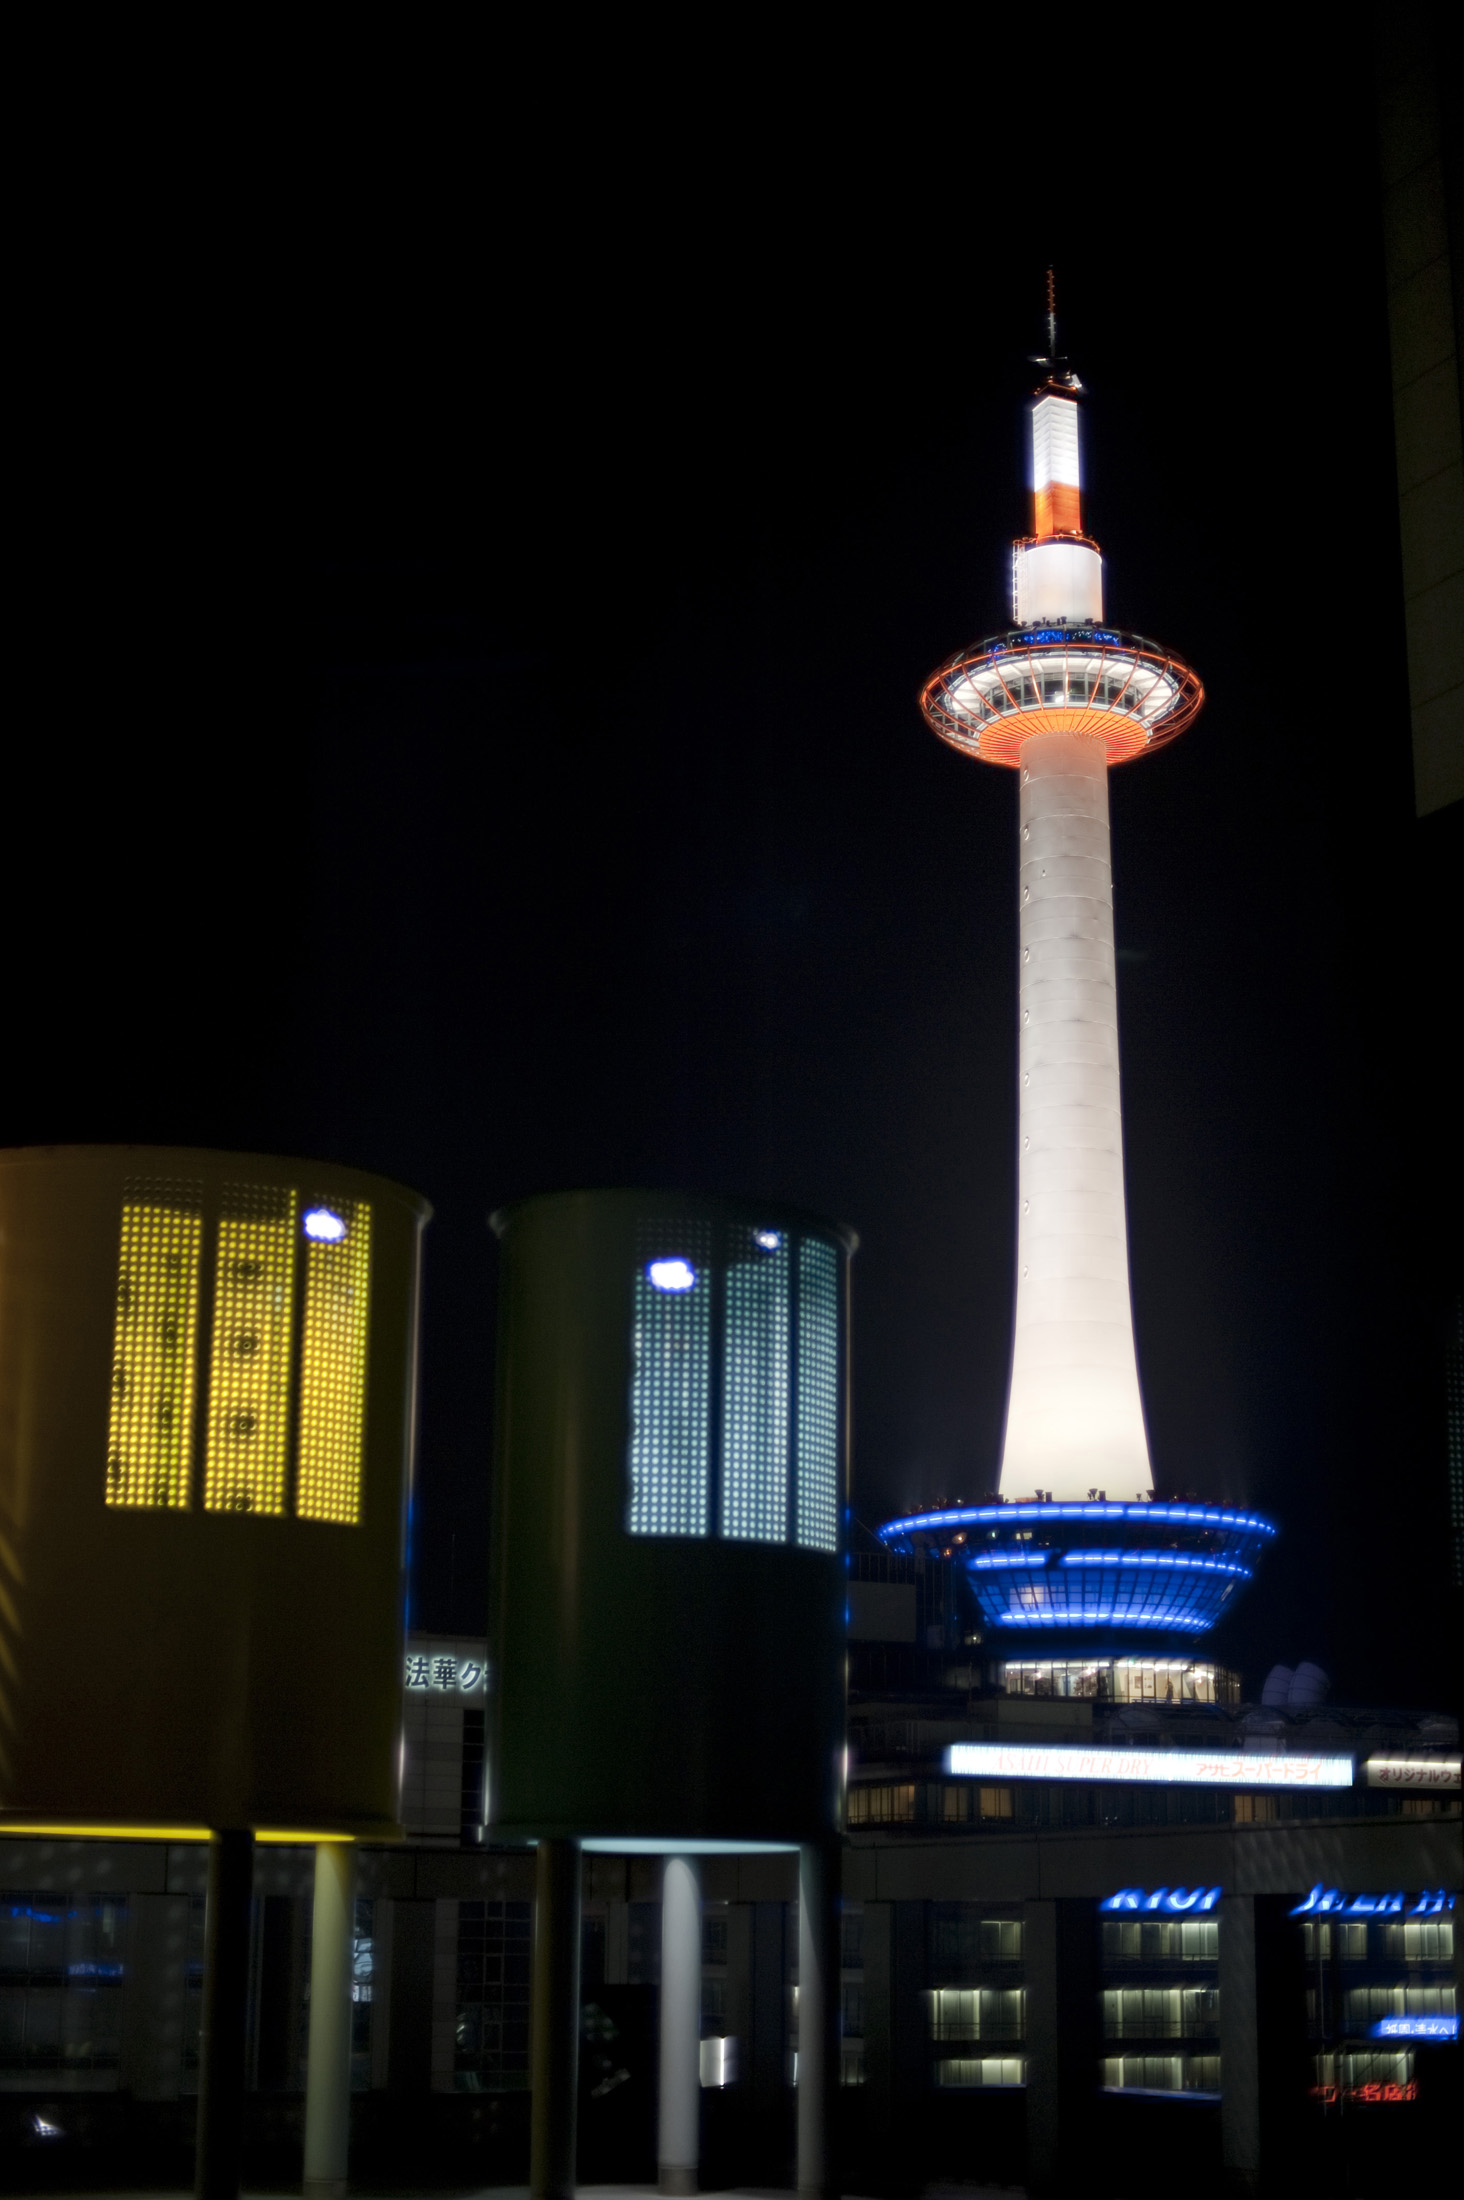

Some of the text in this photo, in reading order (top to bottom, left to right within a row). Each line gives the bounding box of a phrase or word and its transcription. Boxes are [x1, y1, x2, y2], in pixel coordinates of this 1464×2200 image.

[405, 1656, 487, 1690] 法華ク
[992, 1753, 1154, 1776] ASAHI SUPER DRY
[1196, 1760, 1322, 1781] アサヒスーパードライ
